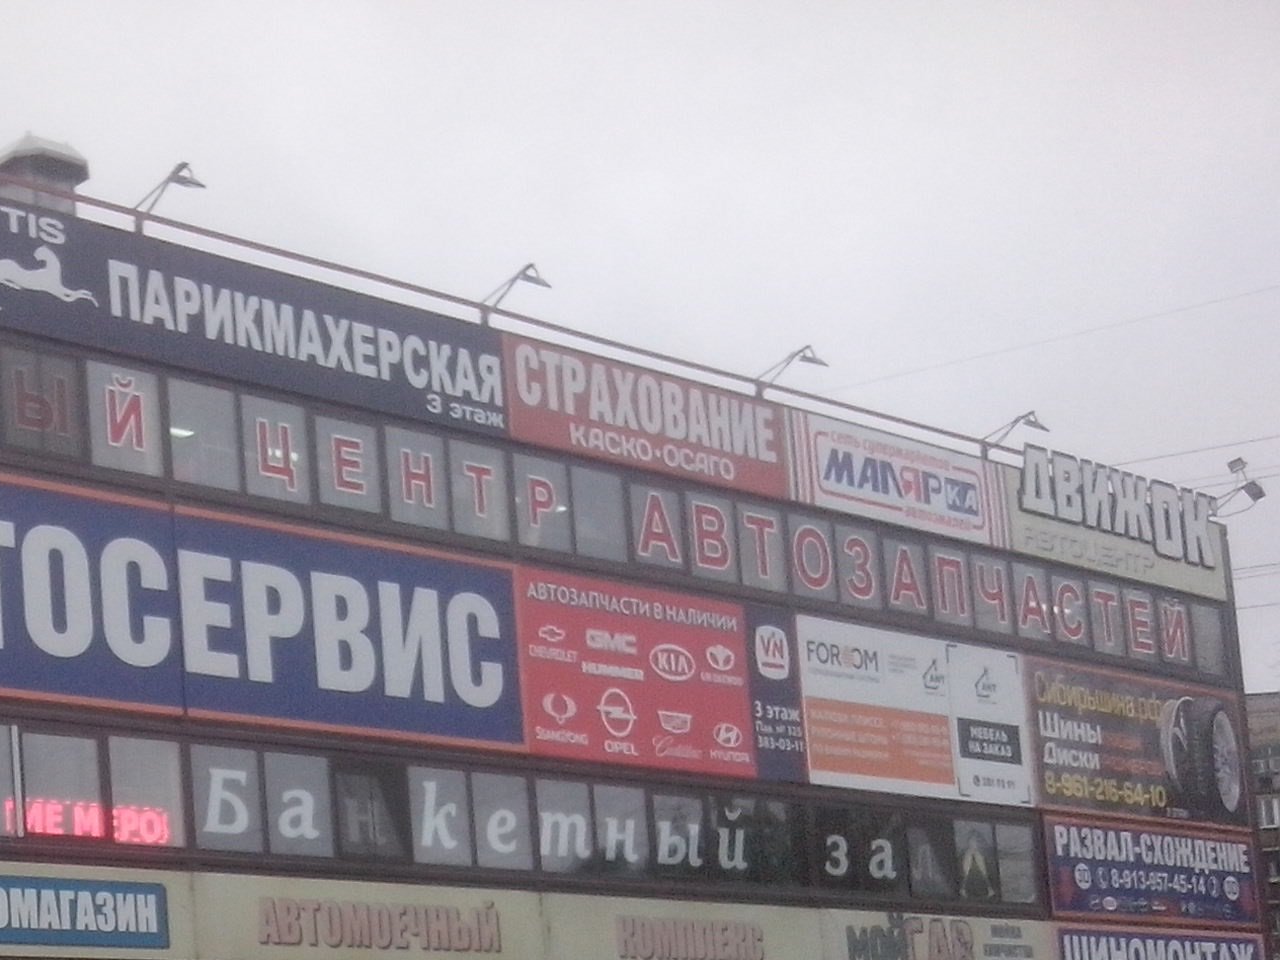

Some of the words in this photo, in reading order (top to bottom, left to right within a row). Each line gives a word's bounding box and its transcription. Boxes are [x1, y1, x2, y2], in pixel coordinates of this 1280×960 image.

[0, 206, 66, 246] TIS
[107, 259, 503, 408] ПАРИКМАХЕРСКАЯ
[426, 394, 442, 413] 3
[448, 399, 505, 429] этаж
[515, 343, 778, 464] СТРАХОВАНИЕ
[822, 448, 978, 515] МАЛЯРКА
[1019, 441, 1218, 571] ДВИЖОК
[255, 416, 563, 530] ЦЕНТР
[637, 491, 1190, 662] АВТОЗАПЧАСТЕЙ
[527, 581, 650, 616] АВТОЗАПЧАСТИ
[653, 602, 664, 620] В
[666, 604, 738, 632] НАЛИЧИИ
[586, 628, 638, 655] GMC
[657, 652, 689, 675] KIA
[754, 700, 763, 718] 3
[766, 704, 801, 722] этаж
[1037, 709, 1103, 746] Шины
[604, 740, 639, 756] OPEL
[969, 726, 1008, 742] МЕБЕЛЬ
[982, 742, 1013, 758] ЗАКАЗ
[1043, 741, 1101, 770] Диски
[203, 768, 749, 873] Банкетный
[1053, 825, 1251, 875] РАЗВАЛ-СХОЖДЕНИЕ
[258, 896, 502, 955] АВТОМОЕЧНЫЙ
